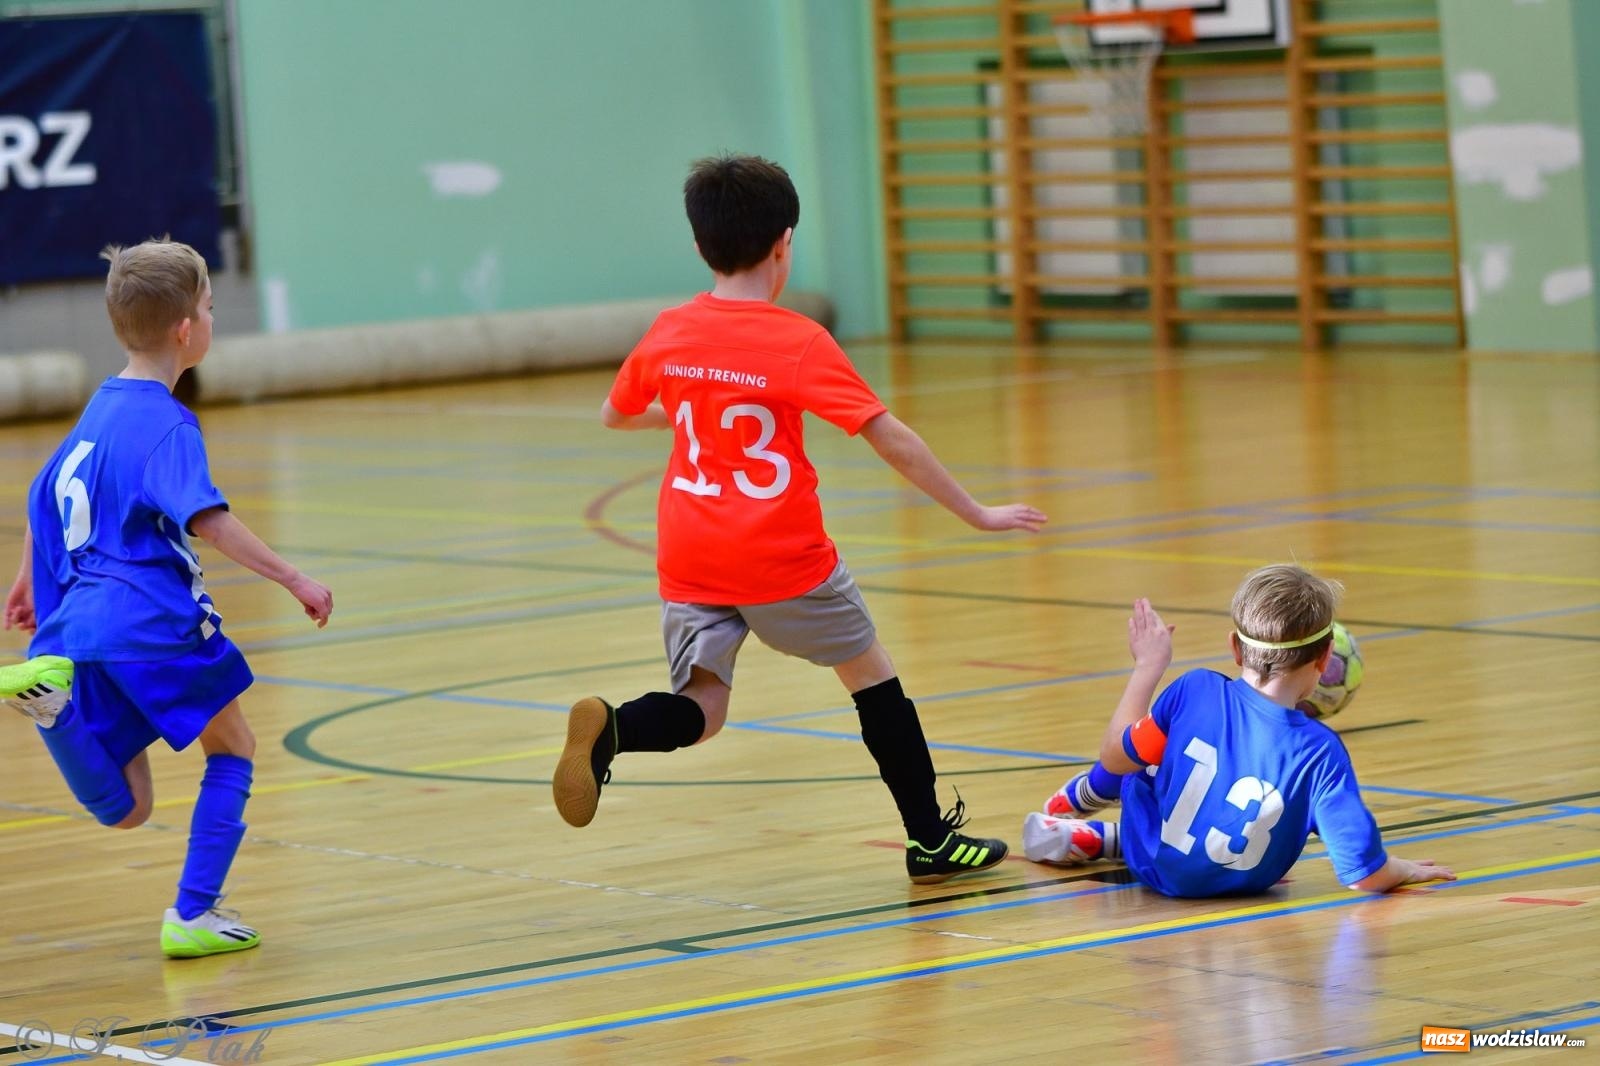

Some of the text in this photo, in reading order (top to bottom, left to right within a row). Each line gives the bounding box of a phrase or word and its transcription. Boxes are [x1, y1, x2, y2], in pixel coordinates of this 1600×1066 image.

[664, 364, 767, 388] JUNIOR TRENING
[54, 439, 96, 552] 6
[672, 401, 791, 500] 13
[1160, 736, 1285, 871] 13
